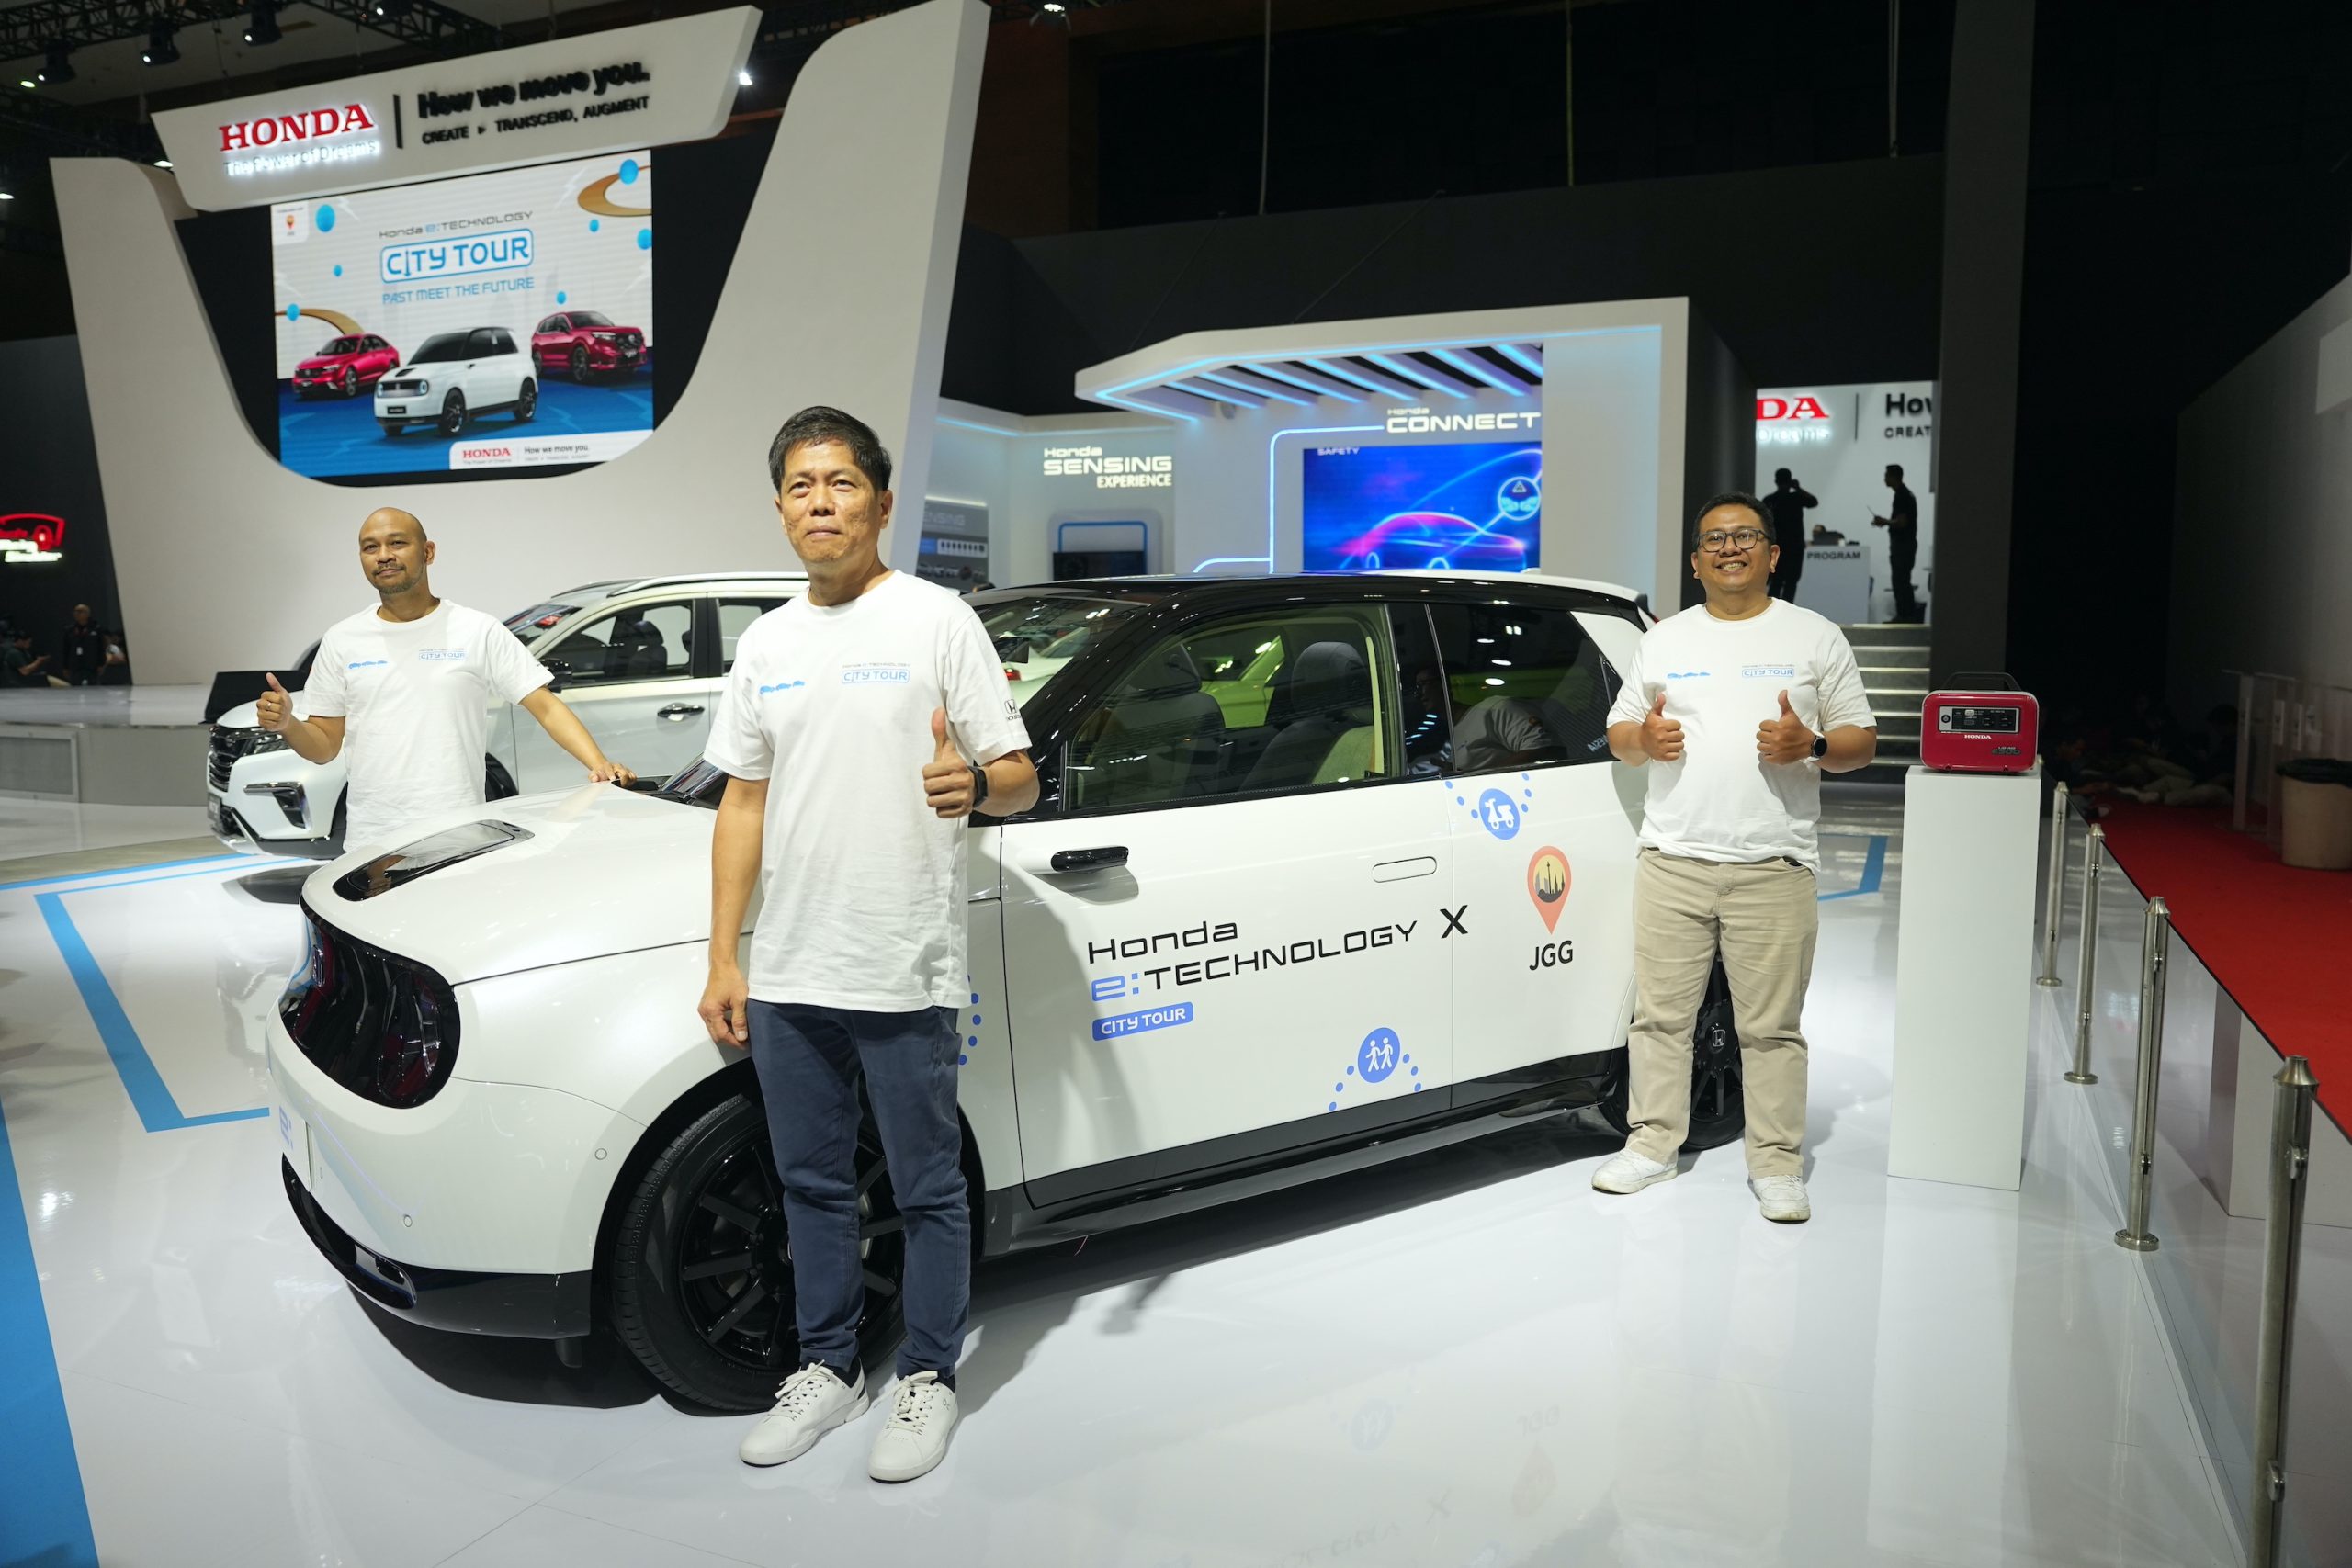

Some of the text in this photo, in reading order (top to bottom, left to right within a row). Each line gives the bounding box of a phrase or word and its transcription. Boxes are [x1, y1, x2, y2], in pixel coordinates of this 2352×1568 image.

[418, 62, 650, 118] How we move you.
[219, 103, 374, 152] HONDA
[422, 96, 650, 144] CREATE TRANSCEND, AUGMENT
[321, 140, 379, 163] Dreams
[379, 226, 424, 239] Honda
[387, 237, 529, 277] CITY TOUR
[382, 277, 535, 305] PAST MEET THE FUTURE
[1387, 407, 1430, 415] Honda
[1386, 412, 1542, 434] CONNECT
[463, 447, 511, 458] HONDA
[1044, 446, 1102, 457] Honda
[1317, 447, 1360, 456] SAFETY
[1043, 456, 1172, 476] SENSING
[1096, 473, 1172, 488] EXPERIENCE
[1807, 551, 1860, 560] PROGRAM
[873, 671, 907, 680] TOUR
[1088, 920, 1238, 964] Honda
[1091, 904, 1469, 1002] e:TECHNOLOGY X
[1529, 940, 1574, 971] JGG
[1101, 1007, 1186, 1035] CITY TOUR
